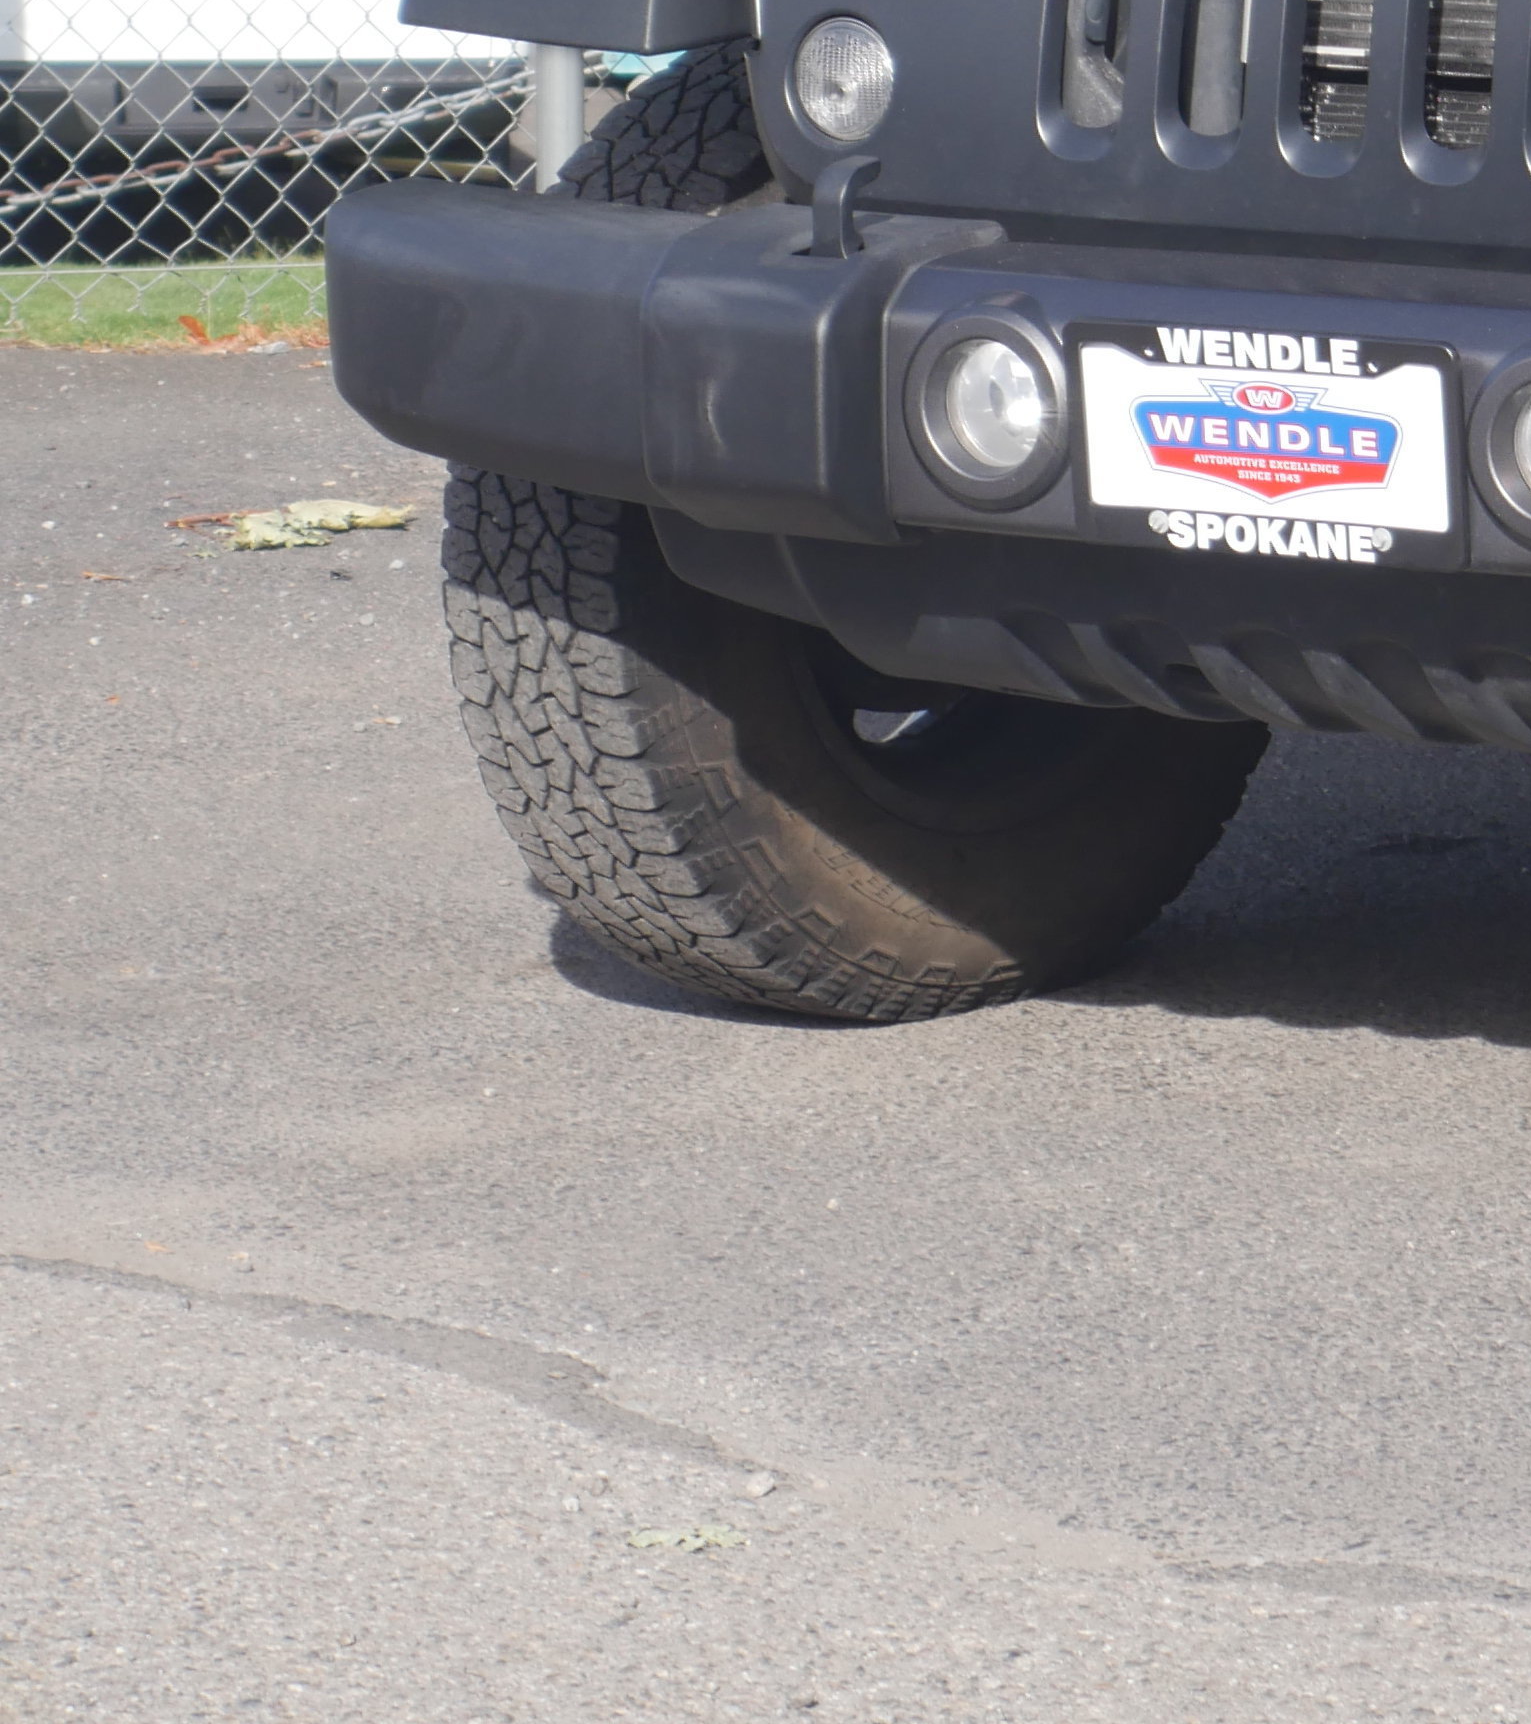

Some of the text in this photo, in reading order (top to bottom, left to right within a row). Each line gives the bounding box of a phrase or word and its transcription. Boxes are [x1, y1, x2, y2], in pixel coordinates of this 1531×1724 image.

[1157, 327, 1360, 376] WENDLE
[1148, 413, 1379, 458] WENDLE
[1194, 454, 1340, 474] AUTOMOTIVE EXCELLENCE
[1238, 470, 1271, 481] SINCE
[1167, 510, 1377, 563] SPOKANE
